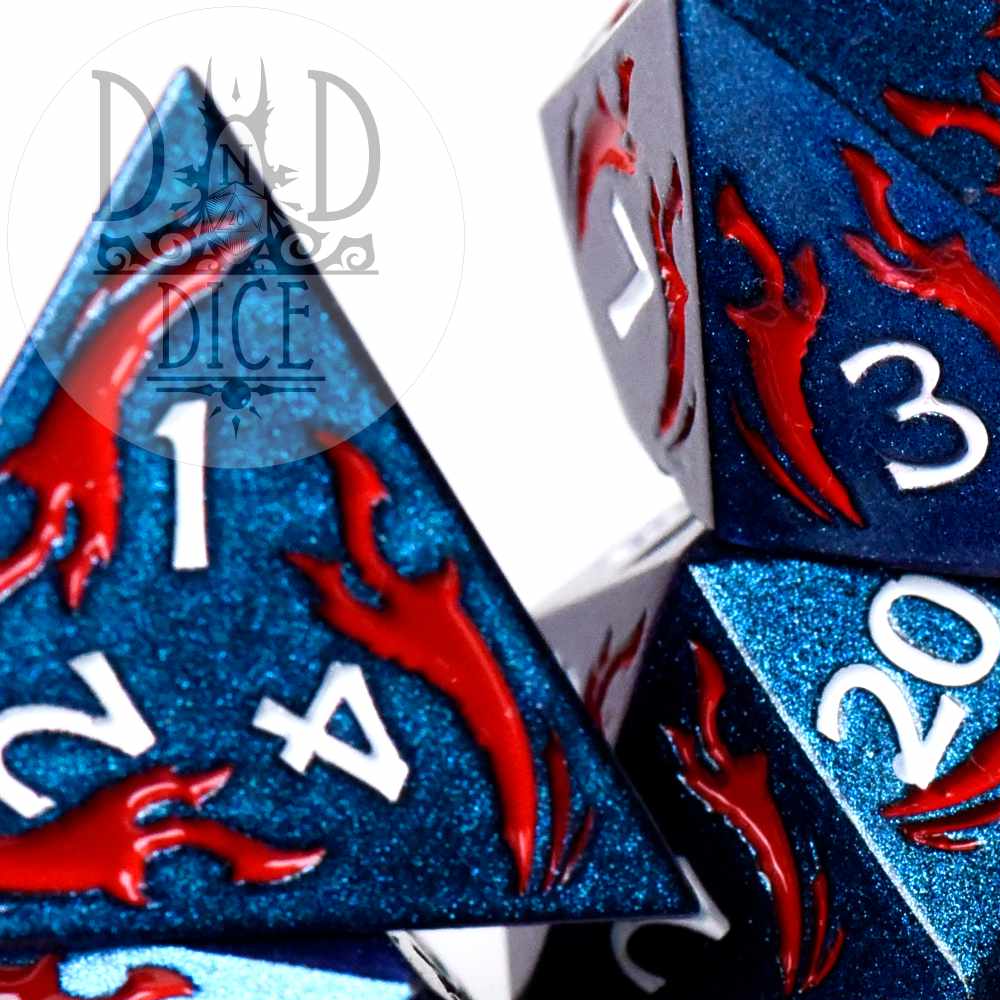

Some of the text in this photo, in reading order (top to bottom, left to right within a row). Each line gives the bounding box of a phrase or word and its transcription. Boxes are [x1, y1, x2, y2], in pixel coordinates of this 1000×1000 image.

[155, 400, 208, 570] 1
[840, 342, 990, 490] 3
[0, 651, 156, 819] 2
[252, 662, 409, 802] 4
